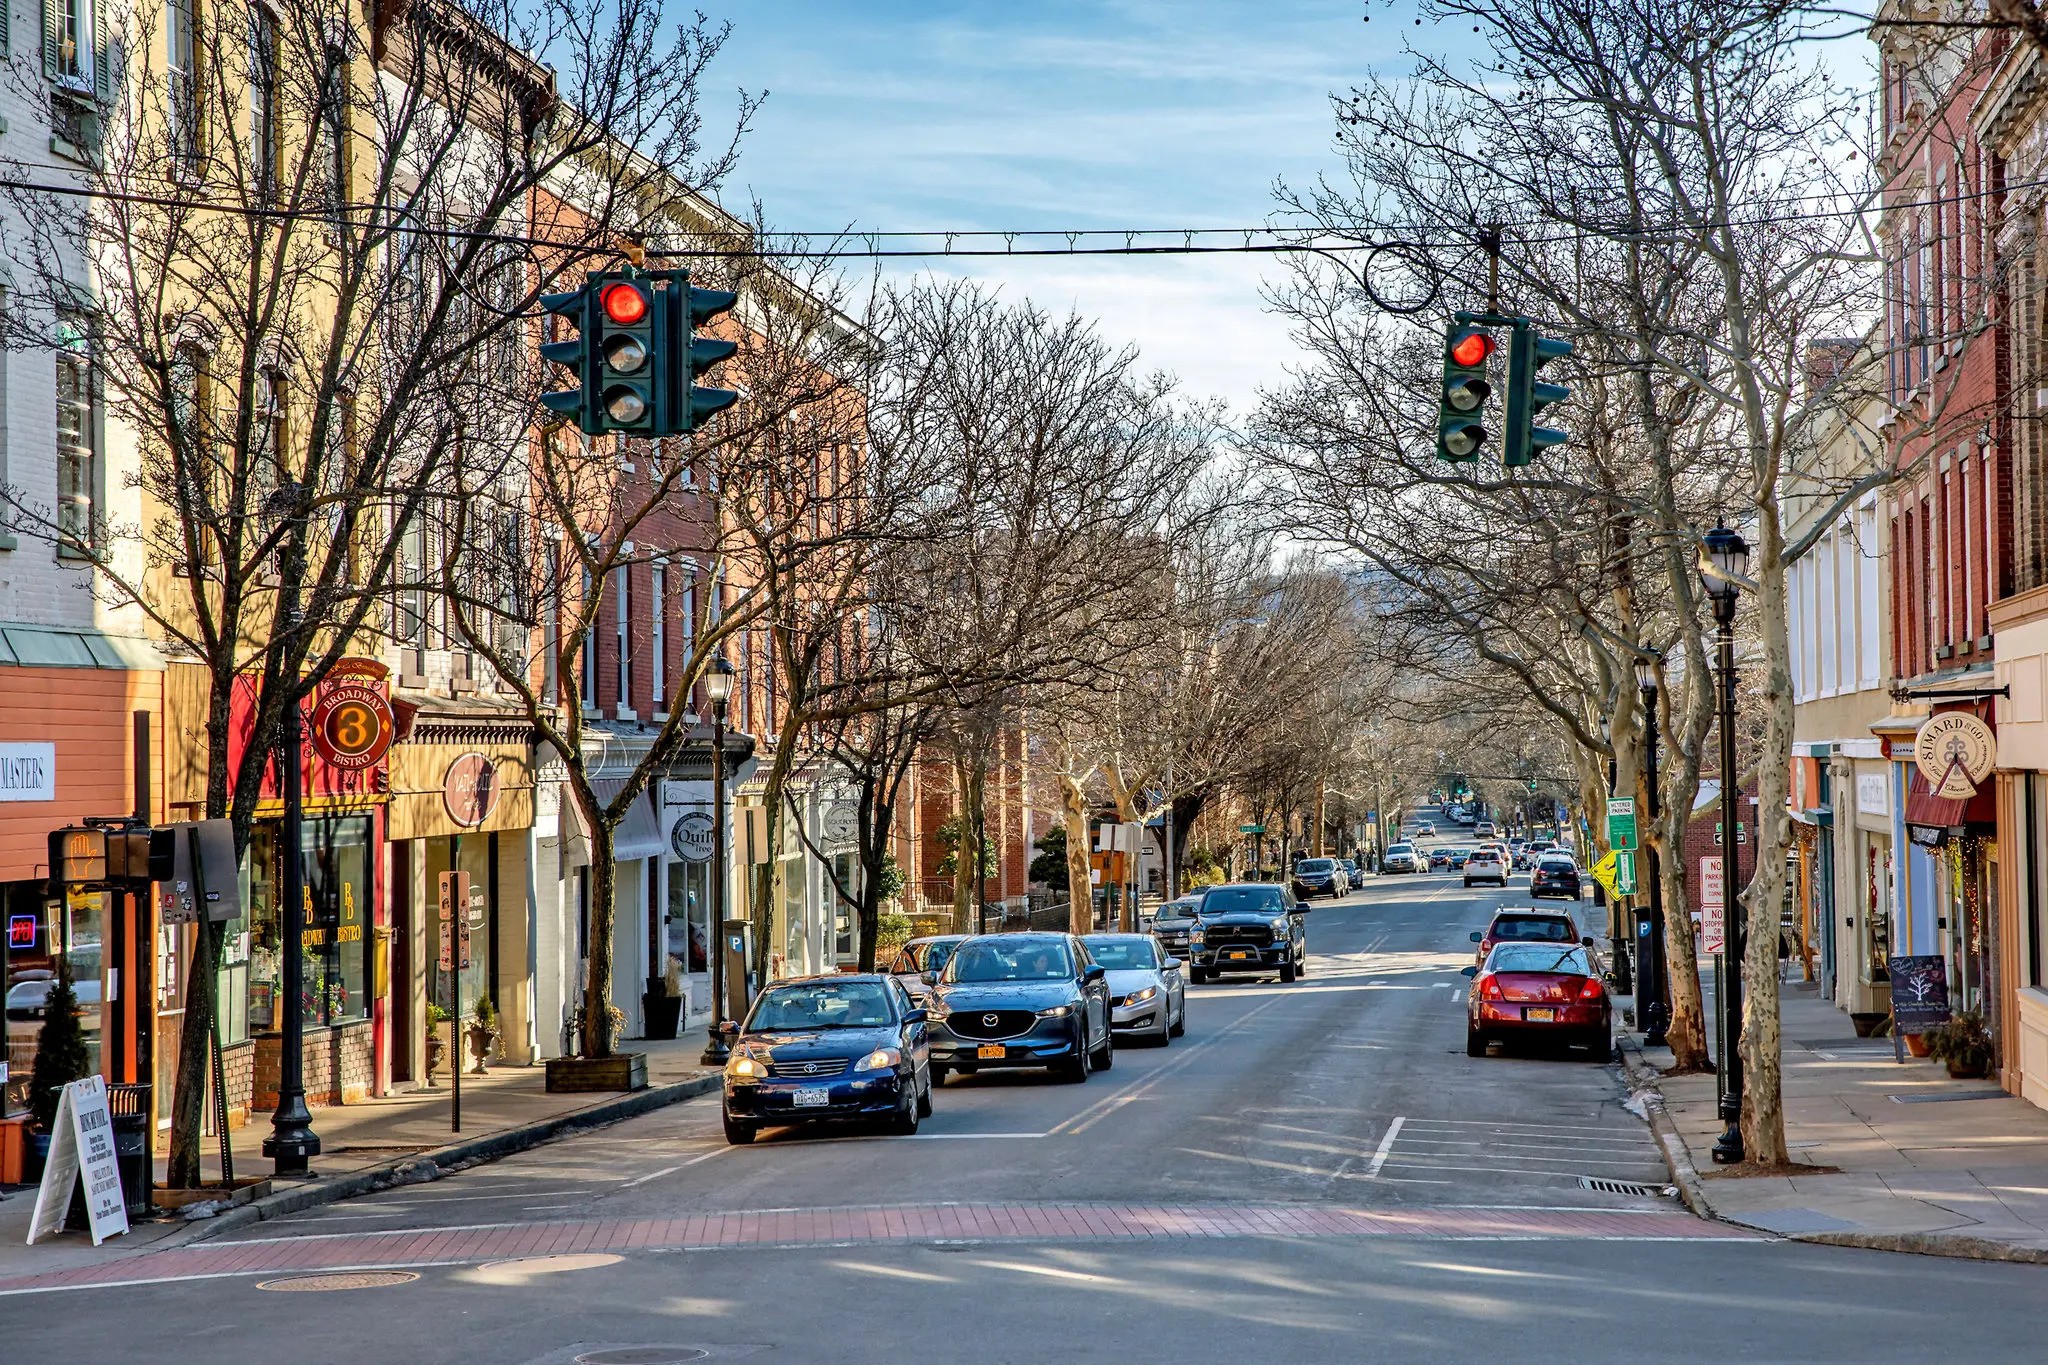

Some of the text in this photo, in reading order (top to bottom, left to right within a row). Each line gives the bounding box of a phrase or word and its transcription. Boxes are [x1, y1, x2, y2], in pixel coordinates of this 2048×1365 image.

[324, 689, 384, 711] BROADWAY
[338, 707, 367, 747] 3
[1922, 718, 1963, 760] SIMARD
[333, 753, 371, 766] BISTRO
[0, 757, 44, 789] MASTERS
[1710, 861, 1722, 871] NO
[1705, 873, 1724, 881] PARKIN
[1711, 909, 1723, 919] NO
[12, 921, 33, 941] OPEN
[337, 925, 361, 942] BISTRO
[1640, 922, 1649, 935] P
[732, 937, 741, 950] P
